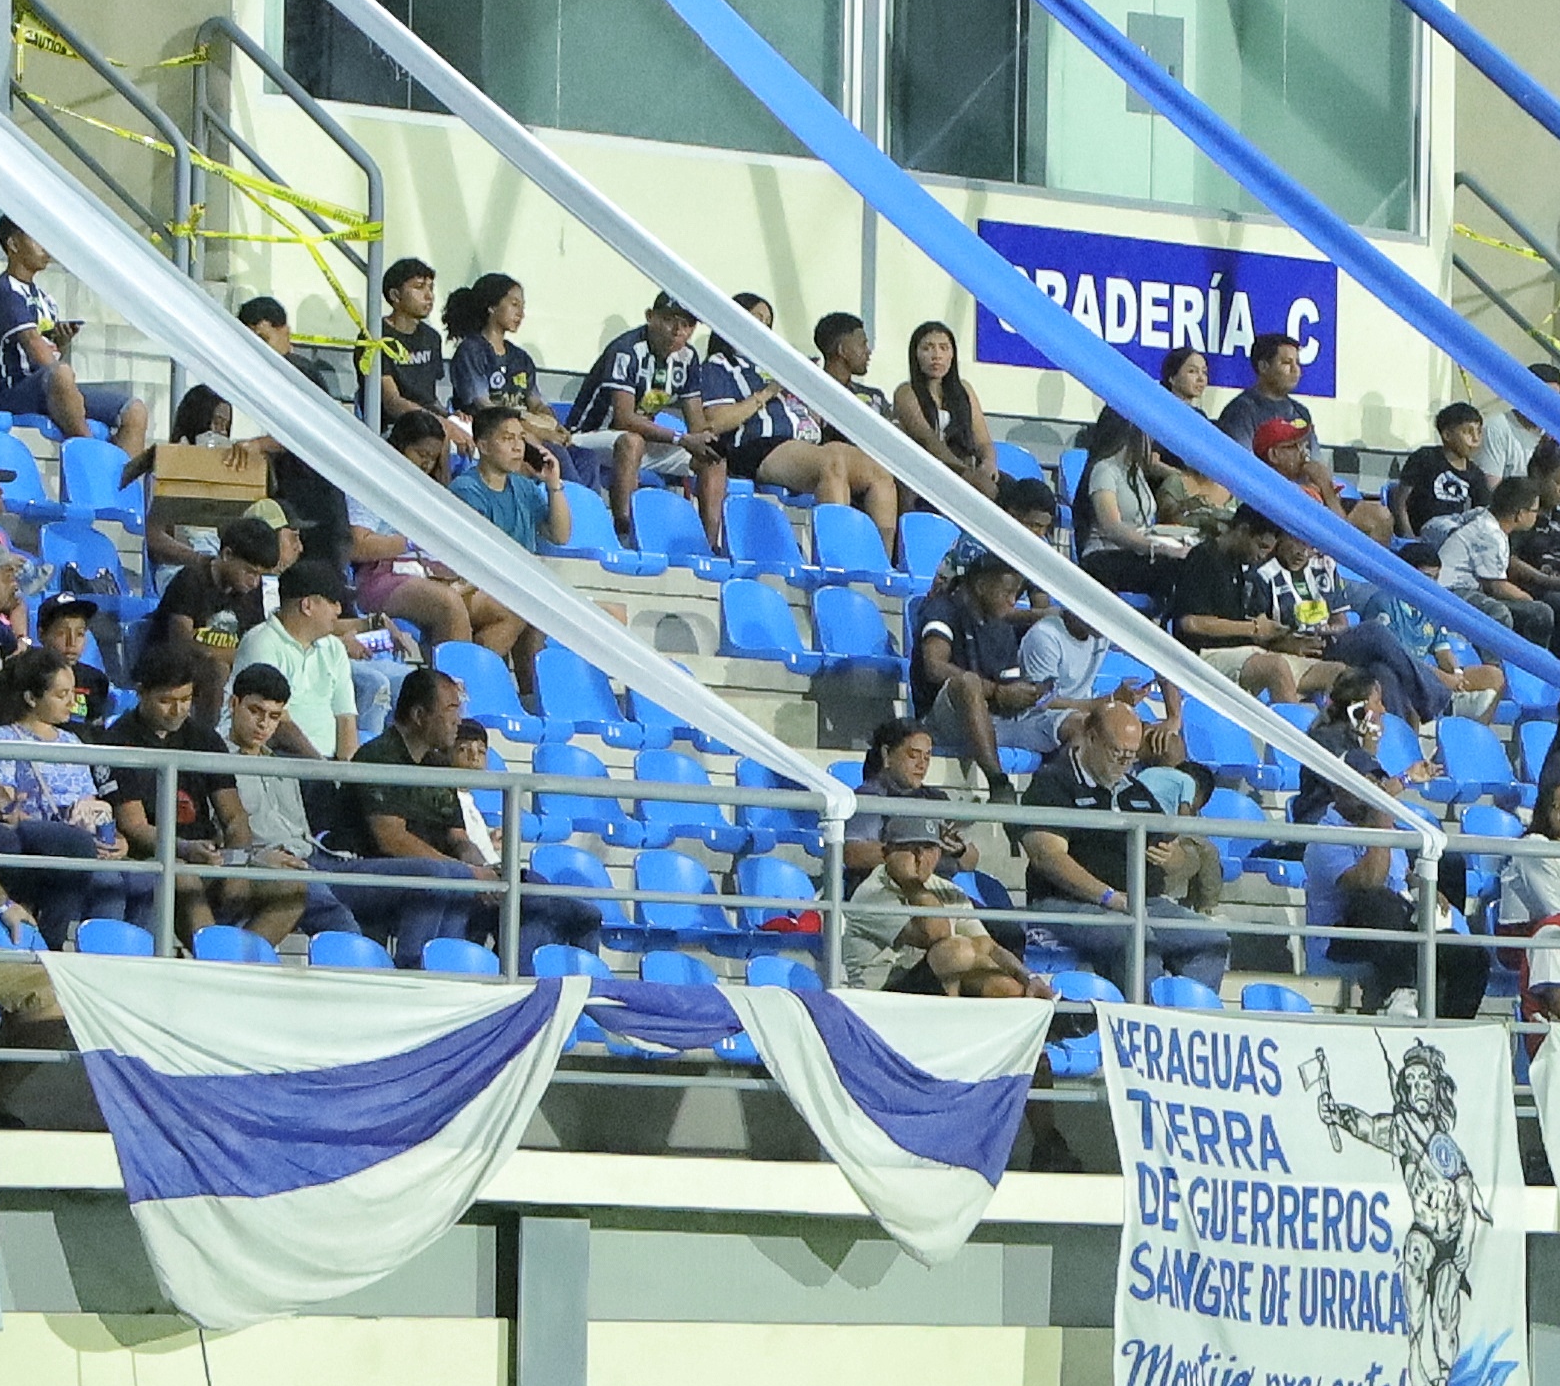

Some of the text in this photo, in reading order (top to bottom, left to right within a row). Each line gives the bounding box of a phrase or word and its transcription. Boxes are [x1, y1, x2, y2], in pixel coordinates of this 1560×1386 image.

[1287, 297, 1320, 365] C
[1108, 1015, 1282, 1097] VERAGUAS
[1127, 1089, 1291, 1174] TIERRA
[1136, 1161, 1401, 1262] DE GUERREROS,
[1129, 1240, 1251, 1325] SANGRE
[1259, 1263, 1291, 1327] DE
